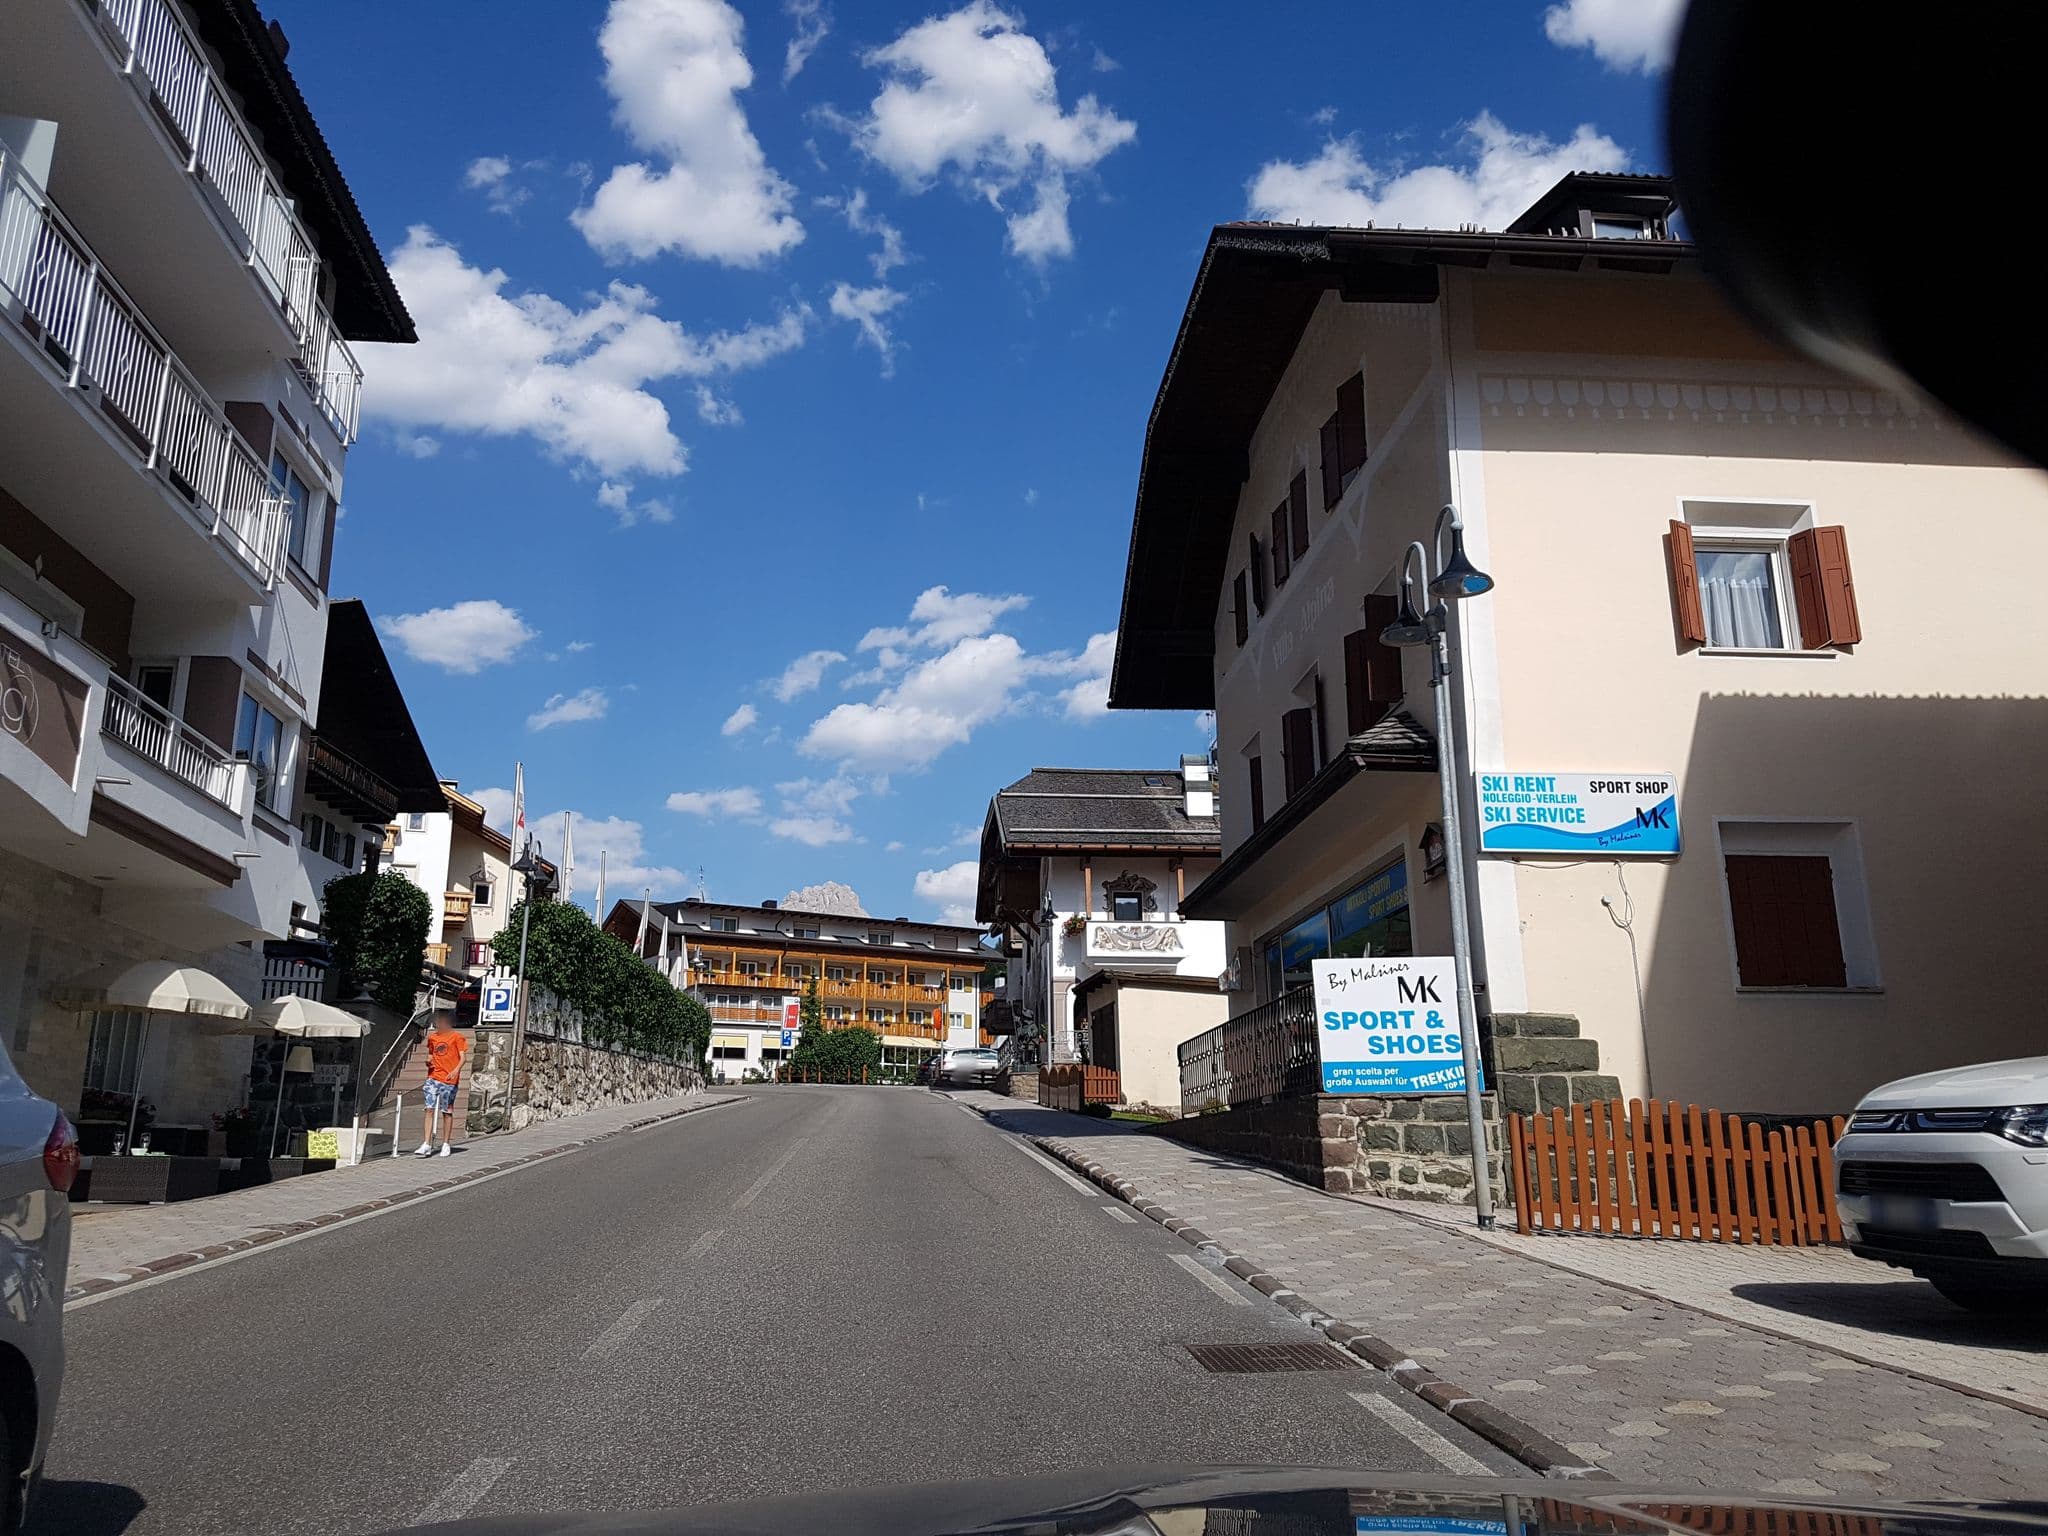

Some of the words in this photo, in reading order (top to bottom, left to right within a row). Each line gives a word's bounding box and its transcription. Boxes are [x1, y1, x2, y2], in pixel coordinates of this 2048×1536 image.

[1482, 776, 1509, 792] SKI
[1514, 777, 1556, 793] RENT
[1590, 781, 1631, 794] SPORT
[1635, 782, 1669, 794] SHOP
[1484, 806, 1511, 822] SKI
[1516, 807, 1585, 823] SERVICE
[1635, 807, 1669, 829] MK
[1328, 973, 1348, 992] By
[1350, 962, 1410, 983] Malsiner
[1397, 975, 1442, 1004] MK
[489, 991, 508, 1010] P
[1323, 1010, 1415, 1030] SPORT
[1425, 1010, 1445, 1029] &
[1368, 1034, 1462, 1055] SHOES
[1332, 1068, 1353, 1078] gran
[1355, 1067, 1382, 1076] scelta
[1384, 1068, 1399, 1077] per
[1355, 1077, 1392, 1086] Auswahl
[1395, 1077, 1408, 1086] für
[1444, 1081, 1457, 1090] TOP
